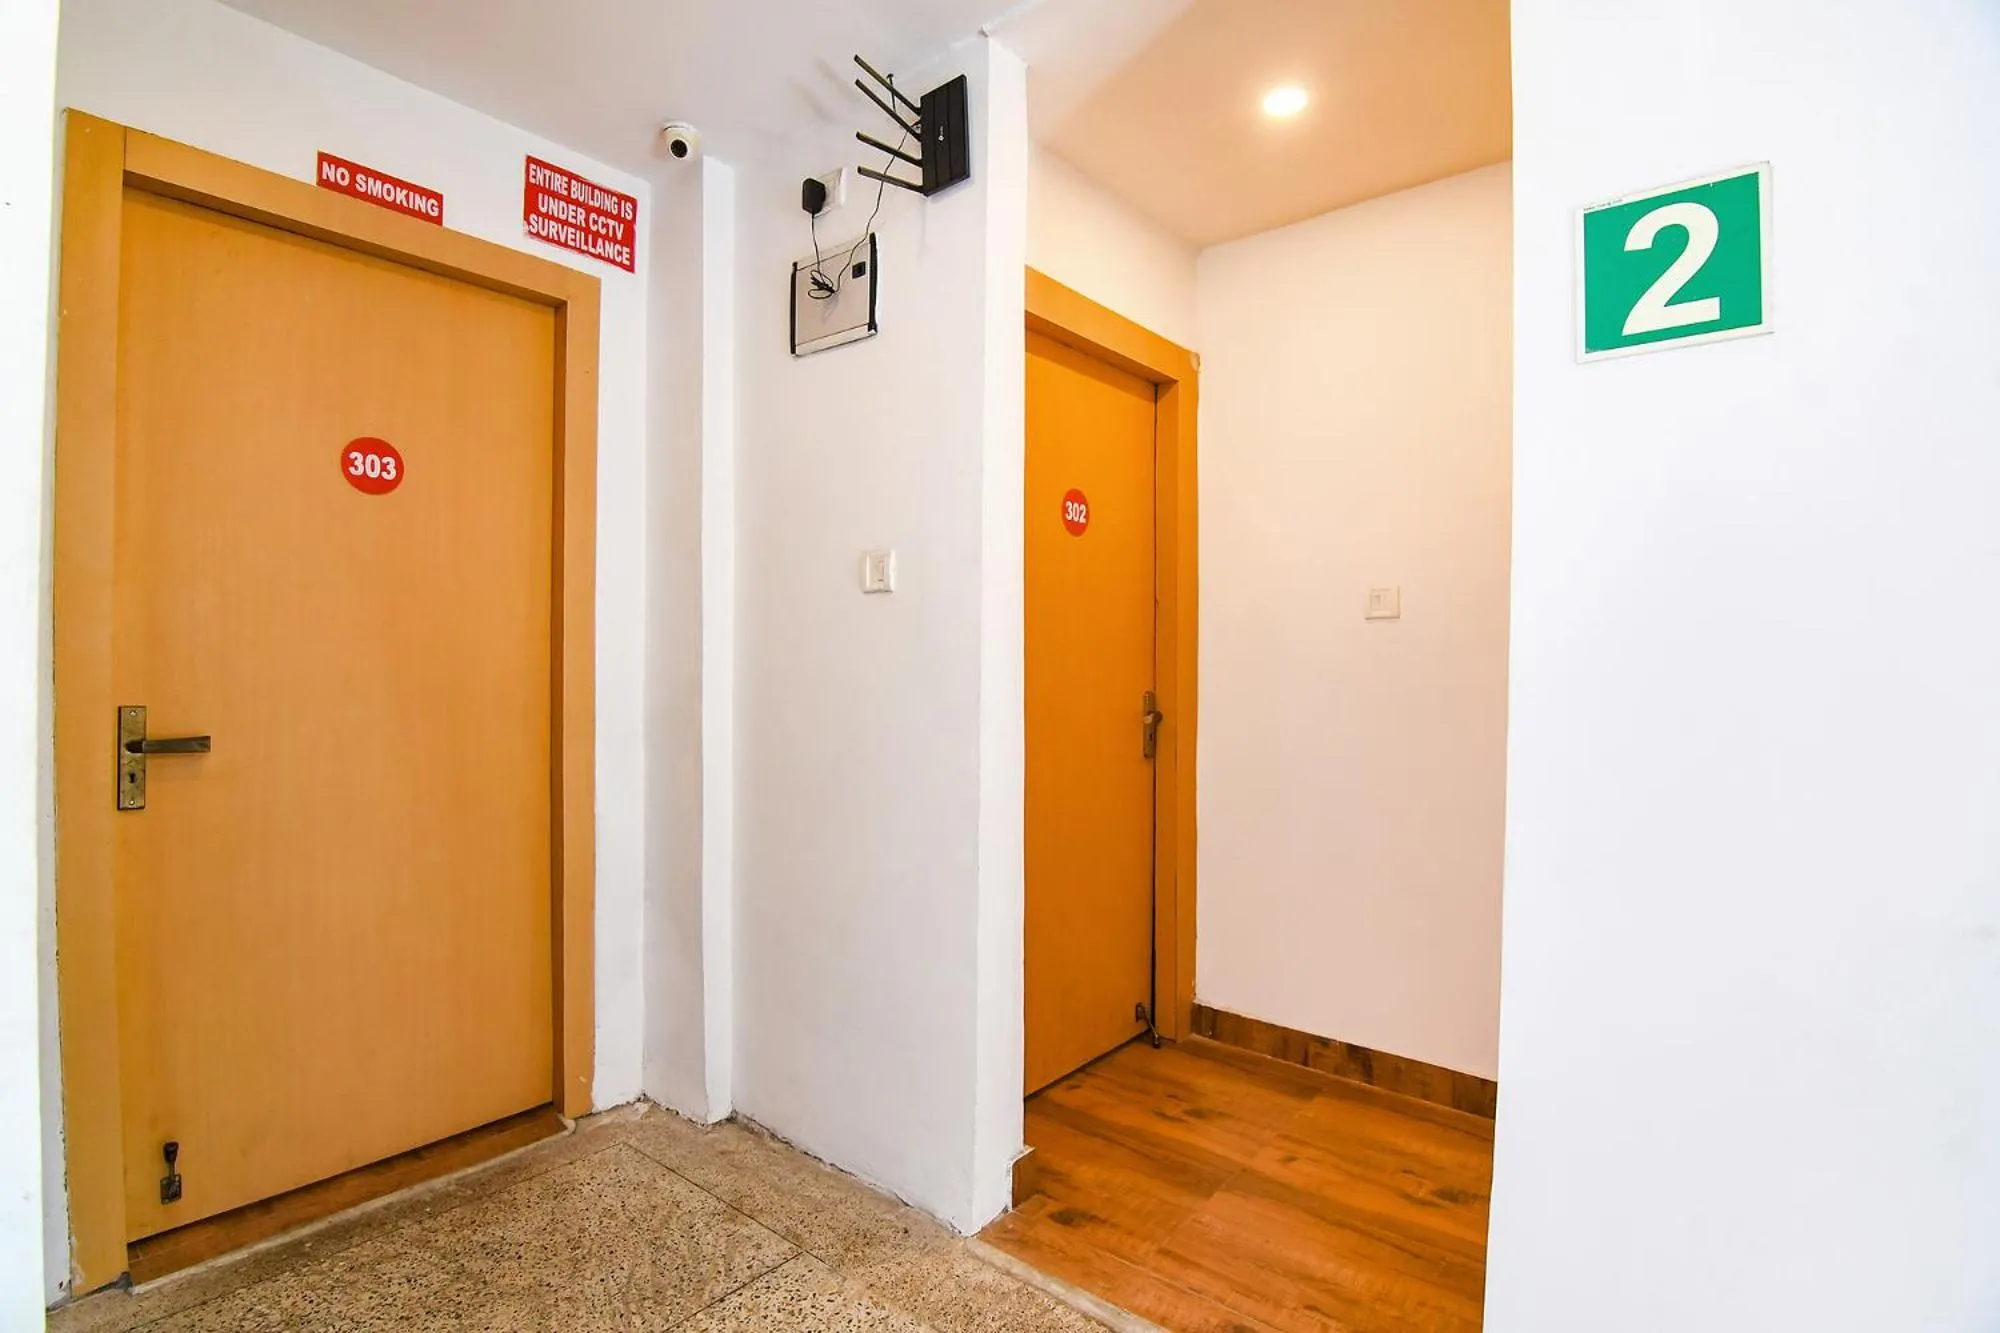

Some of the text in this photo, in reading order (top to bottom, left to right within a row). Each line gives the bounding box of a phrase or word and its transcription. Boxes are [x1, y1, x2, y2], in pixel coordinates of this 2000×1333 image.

[321, 161, 440, 217] NO SMOKING
[528, 163, 633, 220] ENTIRE BUILDING IS
[528, 213, 631, 266] SURVEILLANCE
[538, 193, 624, 240] UNDER CCTV
[1621, 202, 1720, 336] 2
[348, 451, 397, 480] 303
[1065, 500, 1087, 524] 302
